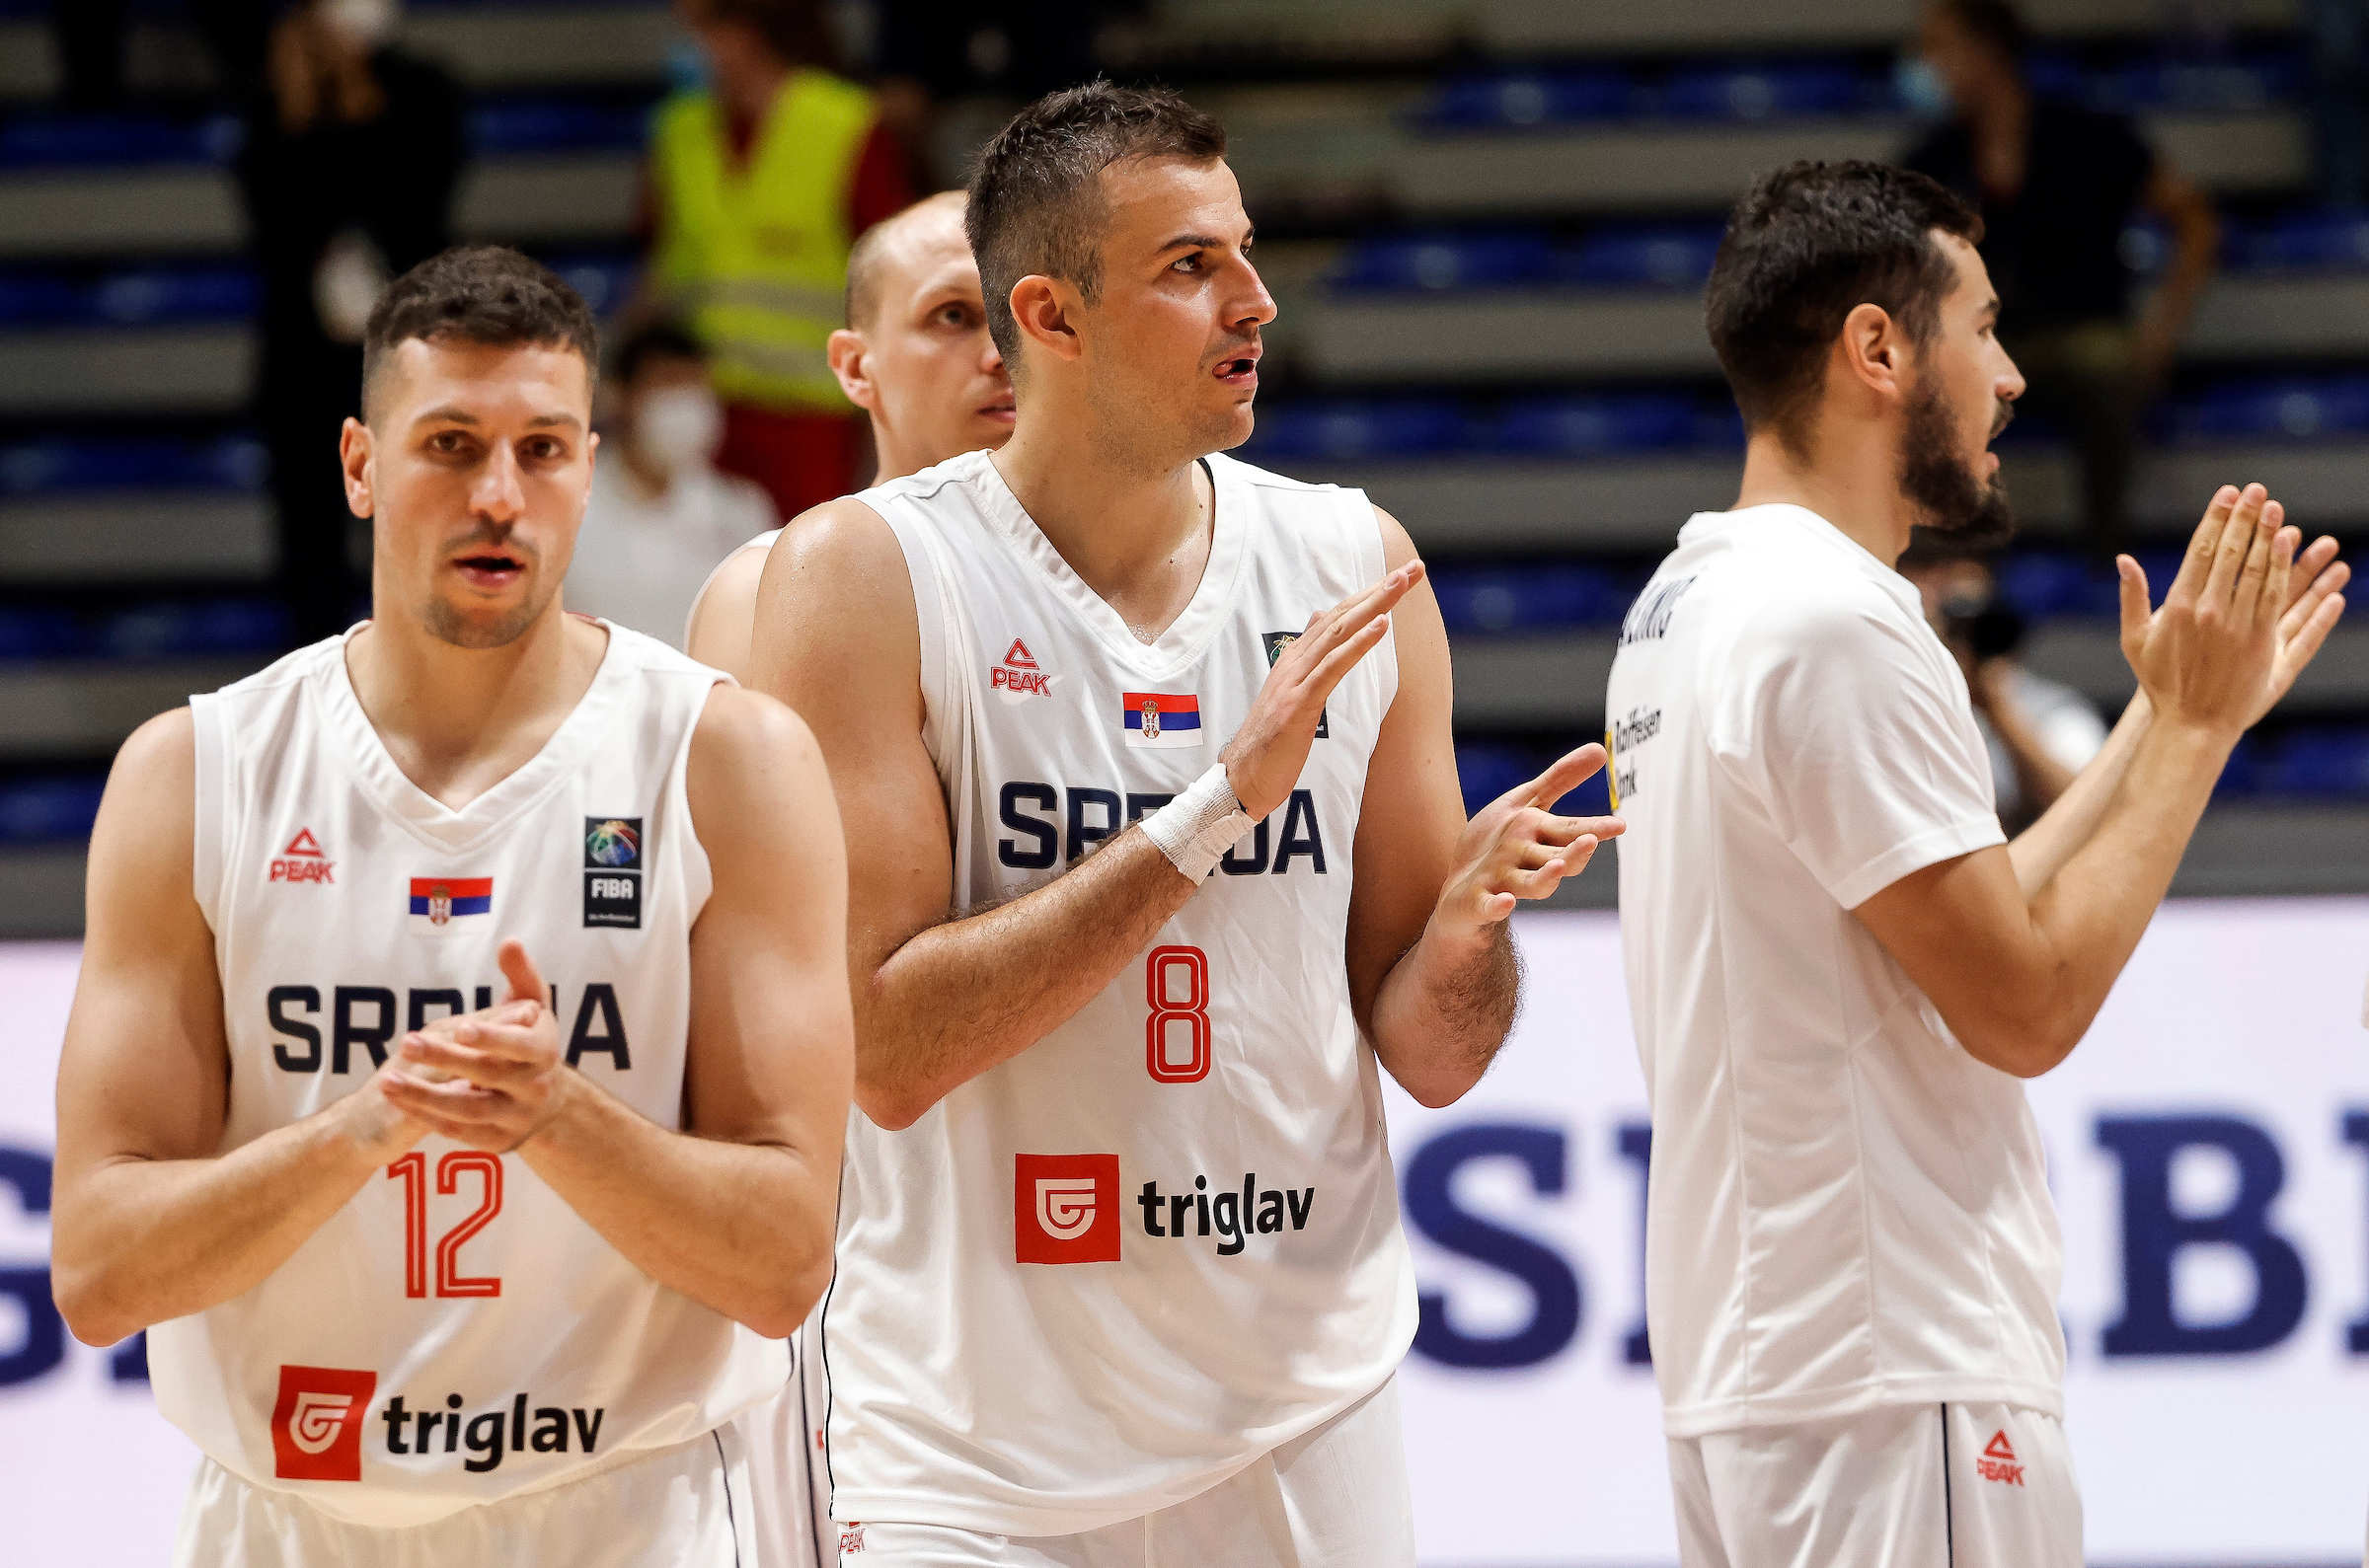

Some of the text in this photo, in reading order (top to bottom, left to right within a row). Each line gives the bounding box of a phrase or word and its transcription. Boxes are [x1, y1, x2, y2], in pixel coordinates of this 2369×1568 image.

[990, 666, 1052, 698] PEAK
[267, 859, 336, 885] PEAK
[590, 877, 635, 899] FIBA
[1146, 944, 1211, 1083] 8
[386, 1150, 503, 1299] 12
[1137, 1172, 1316, 1256] triglav
[382, 1392, 605, 1473] triglav
